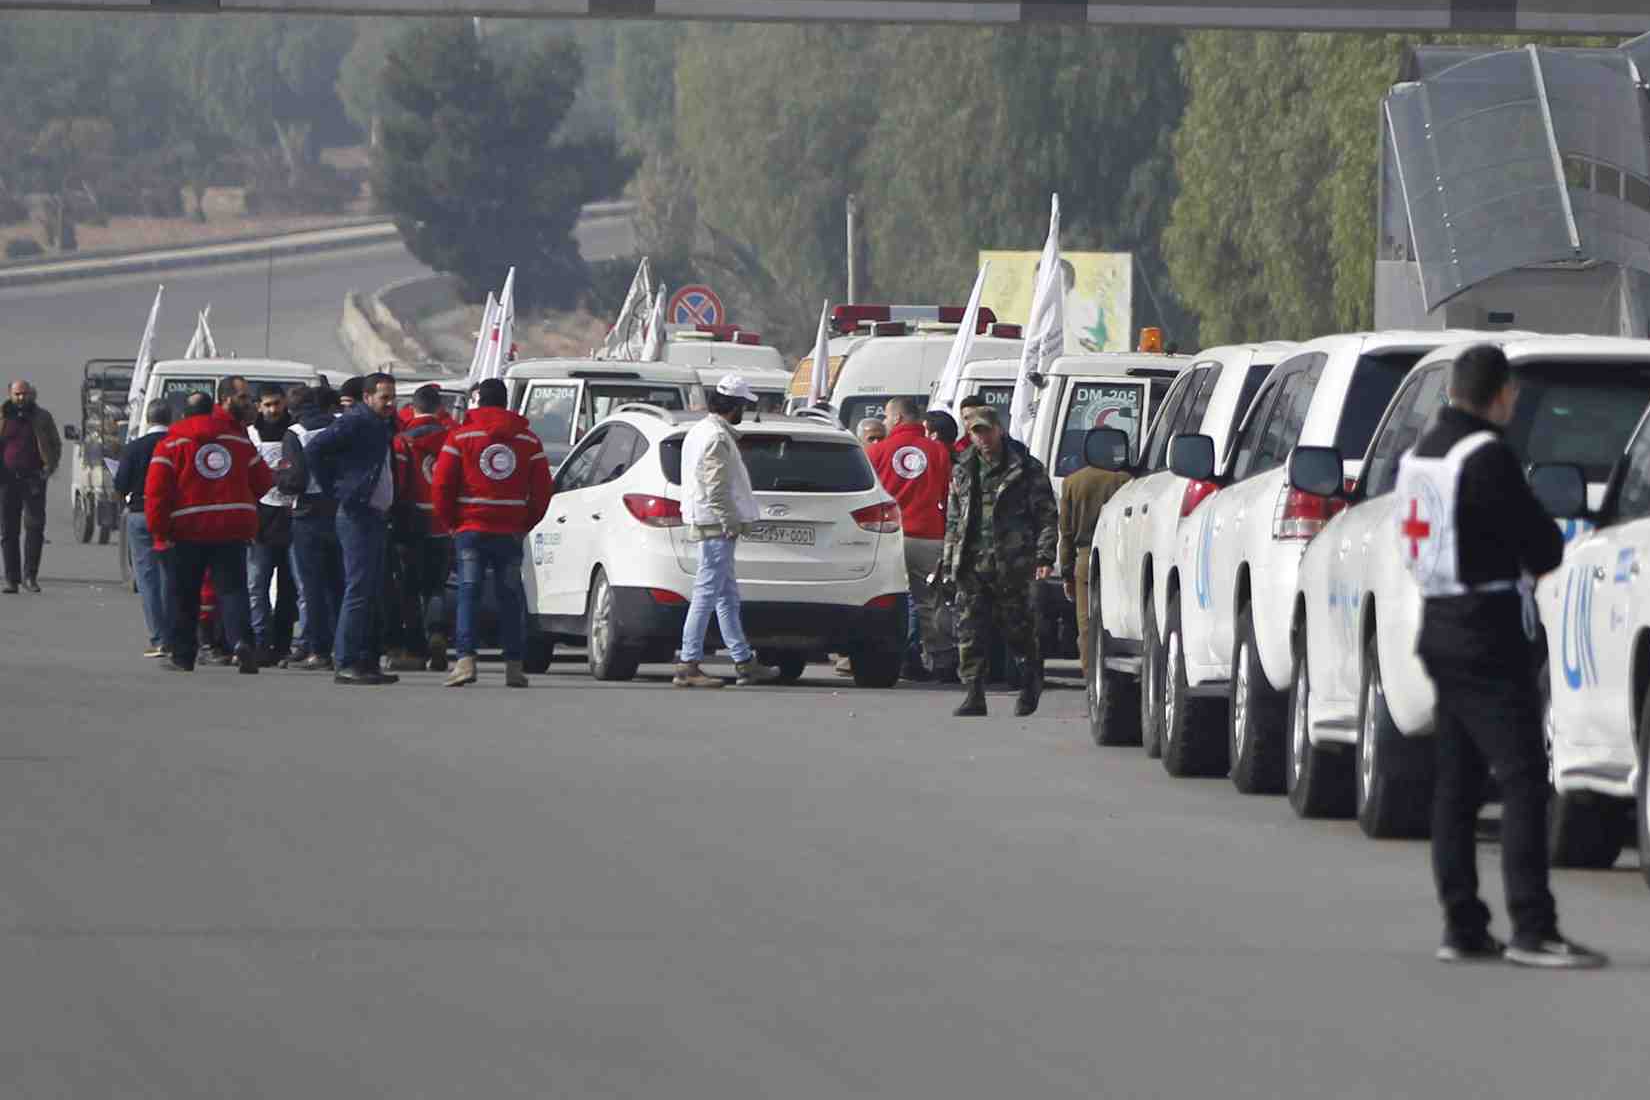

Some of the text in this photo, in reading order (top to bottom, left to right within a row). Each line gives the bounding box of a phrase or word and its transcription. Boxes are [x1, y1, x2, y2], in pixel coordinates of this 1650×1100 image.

[534, 387, 576, 399] DM-204
[984, 391, 1010, 405] DM
[1076, 387, 1138, 403] DM-205
[1562, 567, 1598, 690] UN
